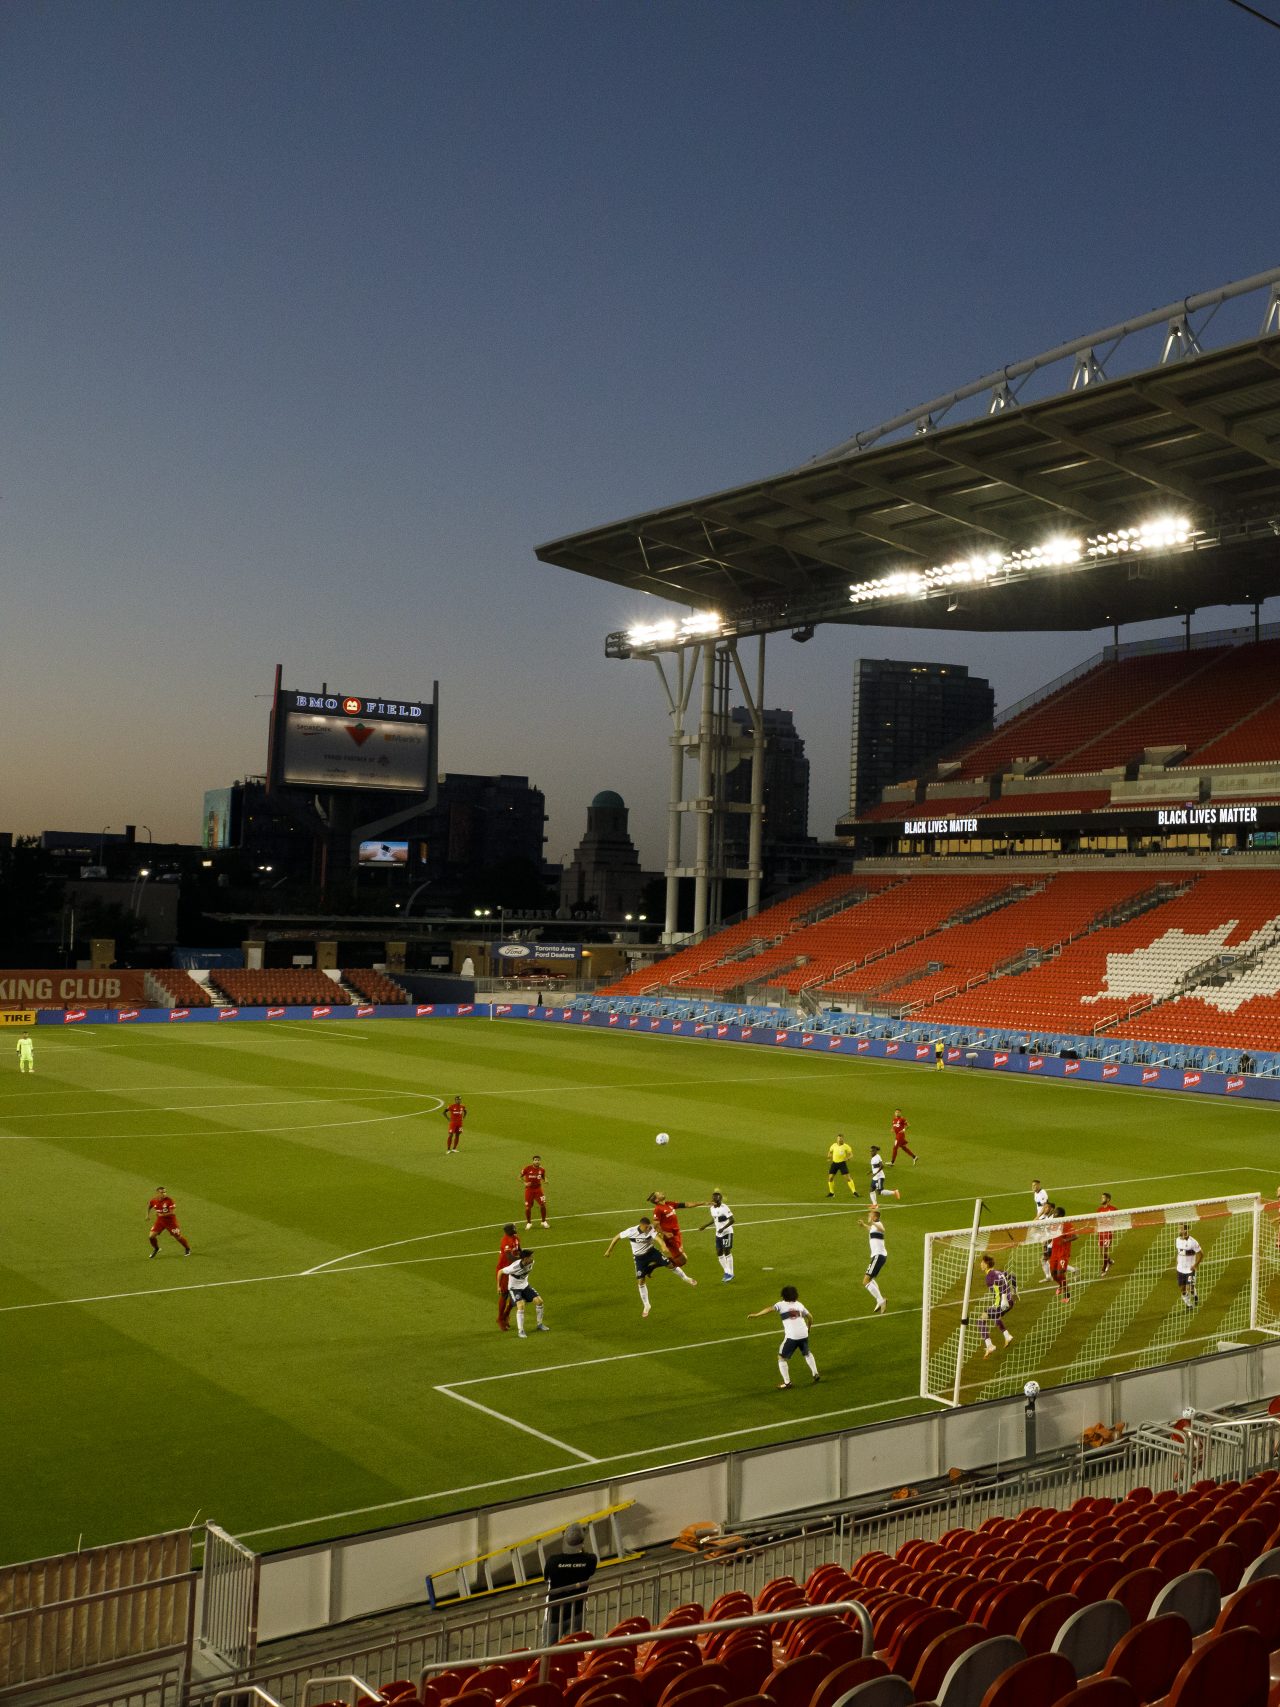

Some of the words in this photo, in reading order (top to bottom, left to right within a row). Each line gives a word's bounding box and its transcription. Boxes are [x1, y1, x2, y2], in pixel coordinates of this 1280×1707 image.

[296, 695, 338, 709] BMO
[366, 702, 422, 717] FIELD
[1158, 810, 1188, 825] BLACK
[1189, 808, 1217, 824] LIVES
[1219, 807, 1257, 823] MATTER
[904, 821, 926, 834] BLACK
[927, 820, 948, 833] LIVES
[949, 819, 978, 832] MATTER
[60, 978, 121, 1000] CLUB
[4, 1014, 32, 1022] TIRE
